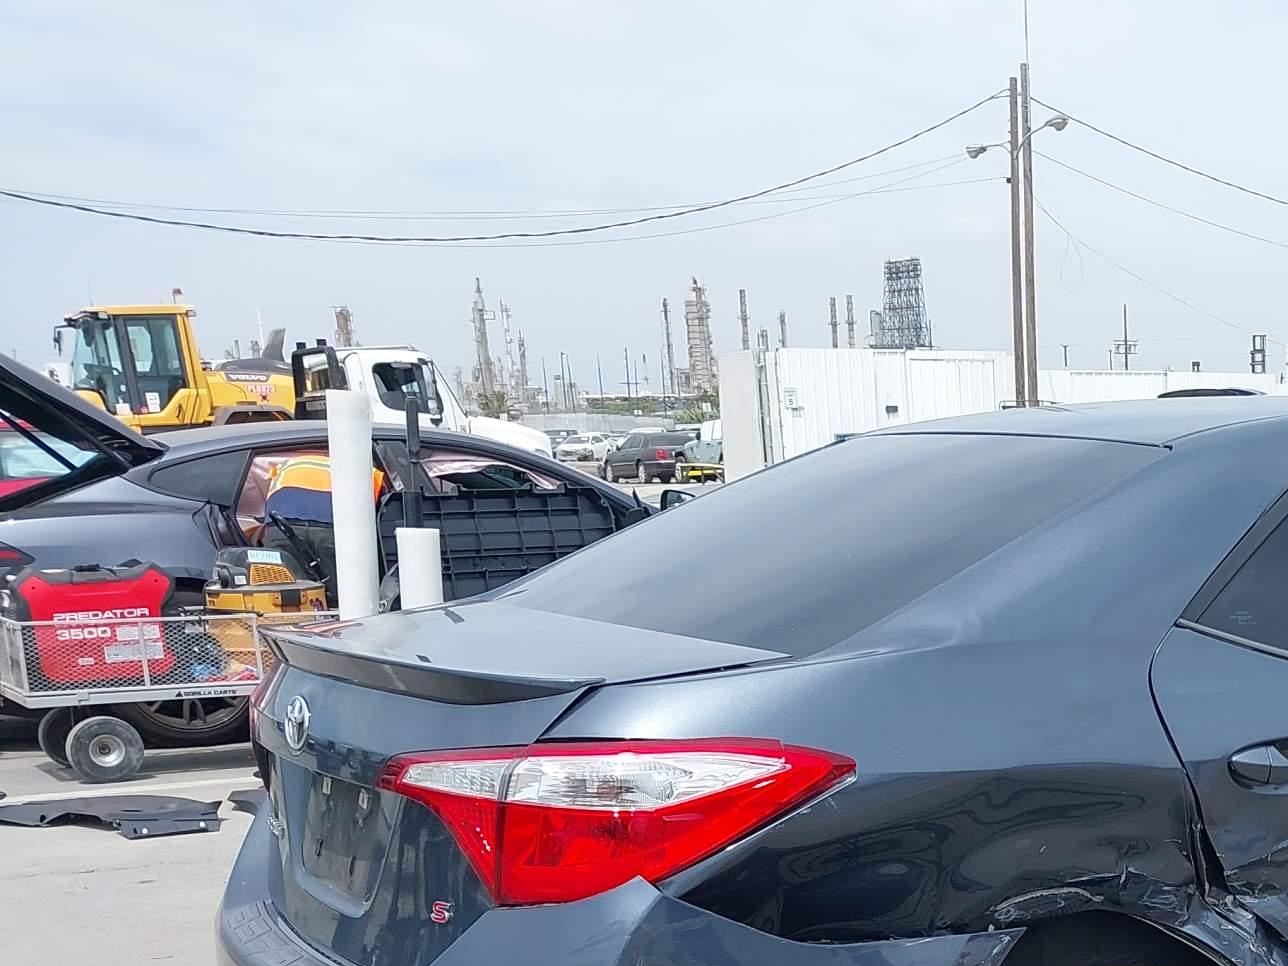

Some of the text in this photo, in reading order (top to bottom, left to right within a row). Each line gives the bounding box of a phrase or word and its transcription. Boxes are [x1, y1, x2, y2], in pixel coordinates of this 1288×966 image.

[53, 607, 149, 623] PREDATOR
[57, 626, 111, 641] 3500
[431, 901, 451, 924] S
